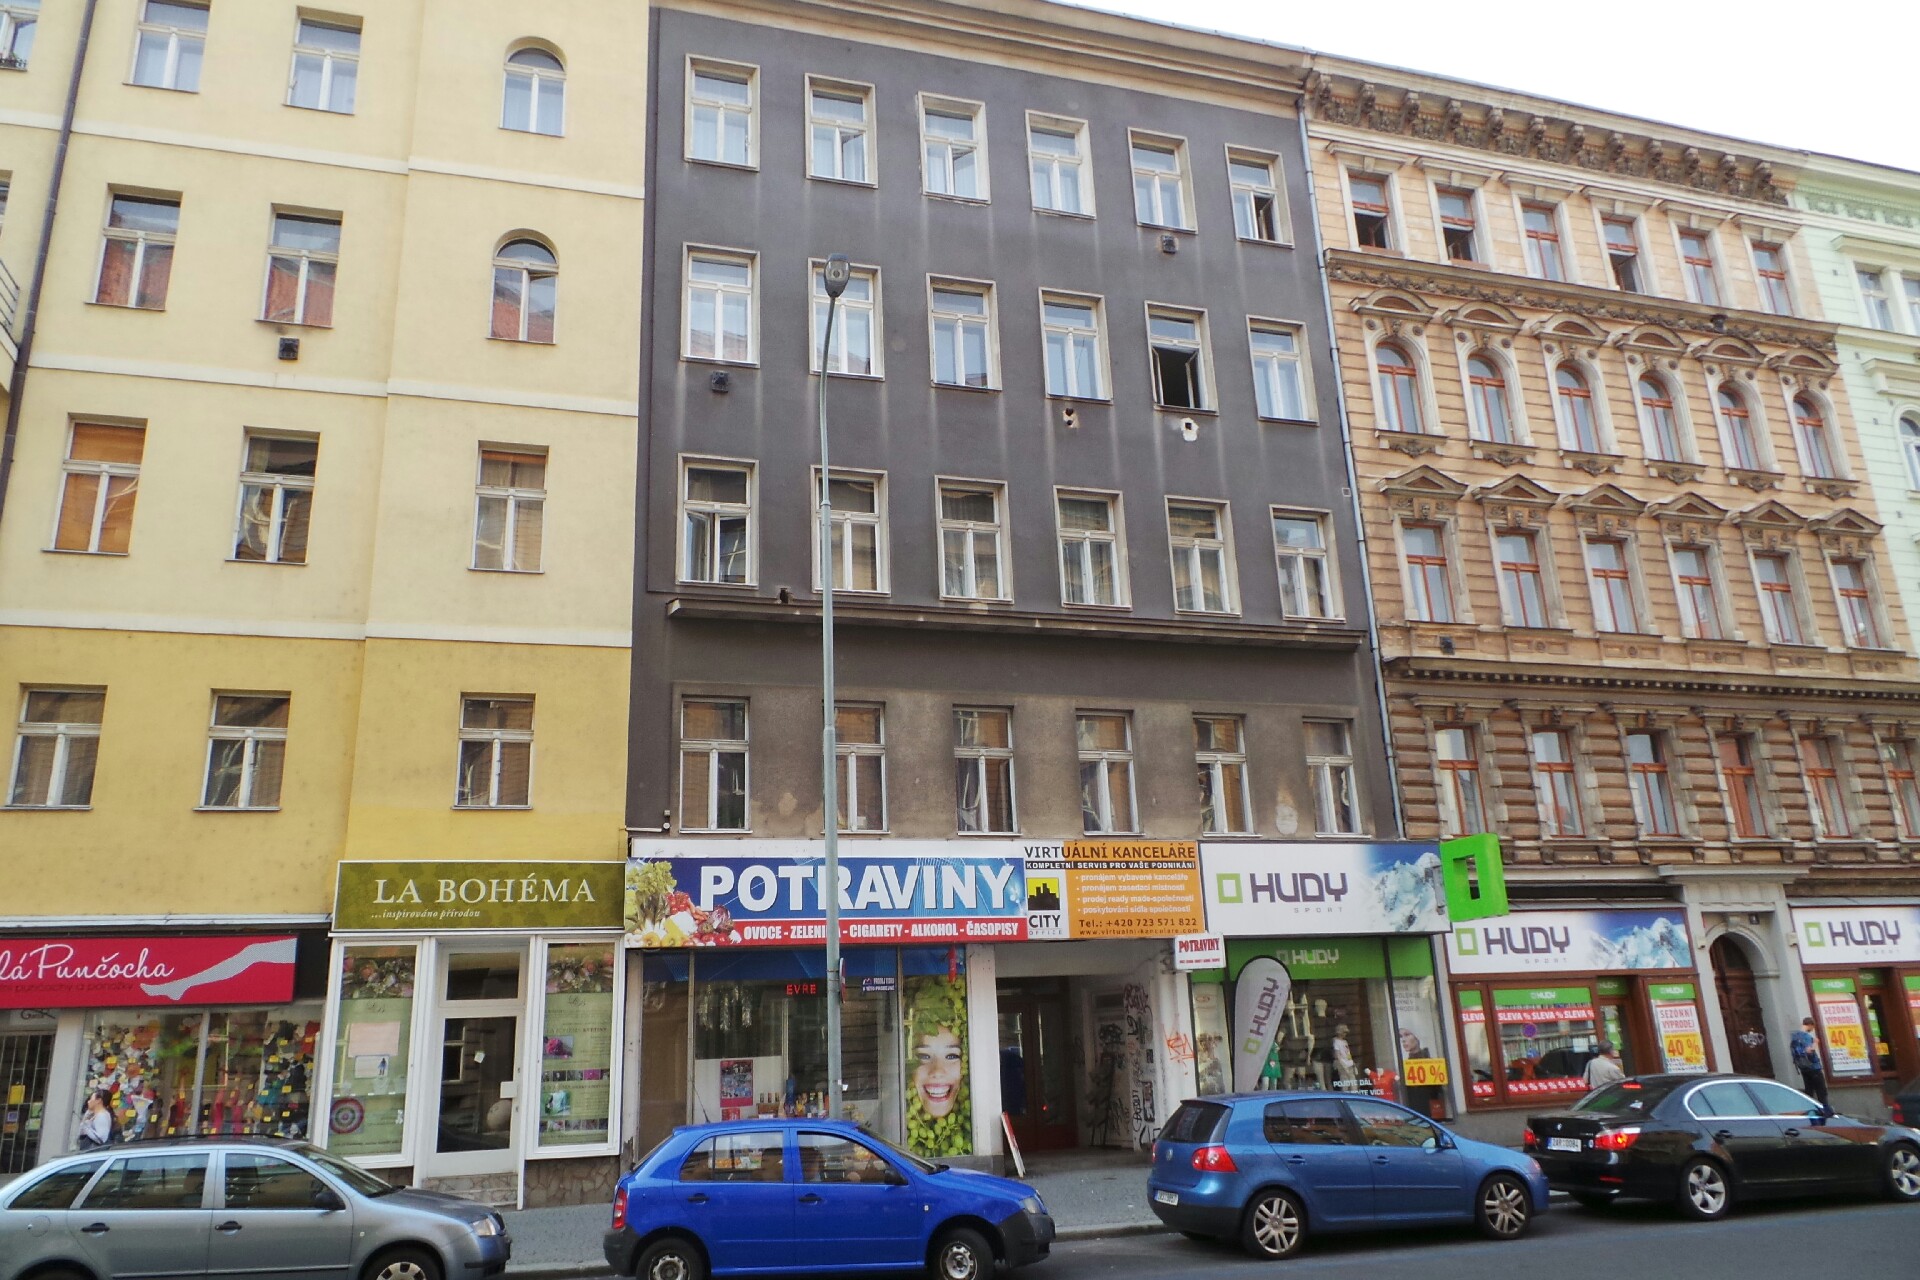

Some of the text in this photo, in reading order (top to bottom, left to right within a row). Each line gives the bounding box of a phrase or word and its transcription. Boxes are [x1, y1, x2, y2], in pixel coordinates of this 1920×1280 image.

[1024, 842, 1195, 859] VIRTUÁLNÍ KANCELÁŘE
[1026, 860, 1195, 869] KOMPLETNÍ SERVIS PRO VAŠE PODNIKÁNÍ
[373, 872, 596, 904] LA BOHÉMA
[700, 865, 1015, 912] POTRAVINY
[1250, 872, 1349, 903] HUDY
[440, 908, 480, 920] přírodou
[1293, 906, 1344, 914] SPORT
[744, 926, 782, 941] OVOCE
[790, 924, 842, 940] ZELENI
[850, 924, 902, 938] CIGARETY
[911, 922, 959, 937] ALKOHOL
[966, 918, 1018, 937] ČASOPISY
[1028, 914, 1061, 928] CITY
[1079, 918, 1197, 928] Tel.: +420 723 571 822
[1483, 926, 1571, 955] HUDY
[1827, 919, 1902, 947] HUDY
[1178, 937, 1220, 953] POTRAVINY
[30, 943, 175, 979] Punčocha
[1292, 949, 1340, 965] HUDY
[1249, 976, 1280, 1037] HUDY
[1498, 1012, 1523, 1021] SLEVA
[1532, 1011, 1555, 1020] SLEVA
[1564, 1009, 1587, 1019] SLEVA
[1462, 1012, 1485, 1022] SLEVA
[1667, 1038, 1684, 1056] 40
[1407, 1064, 1446, 1084] 40 %
